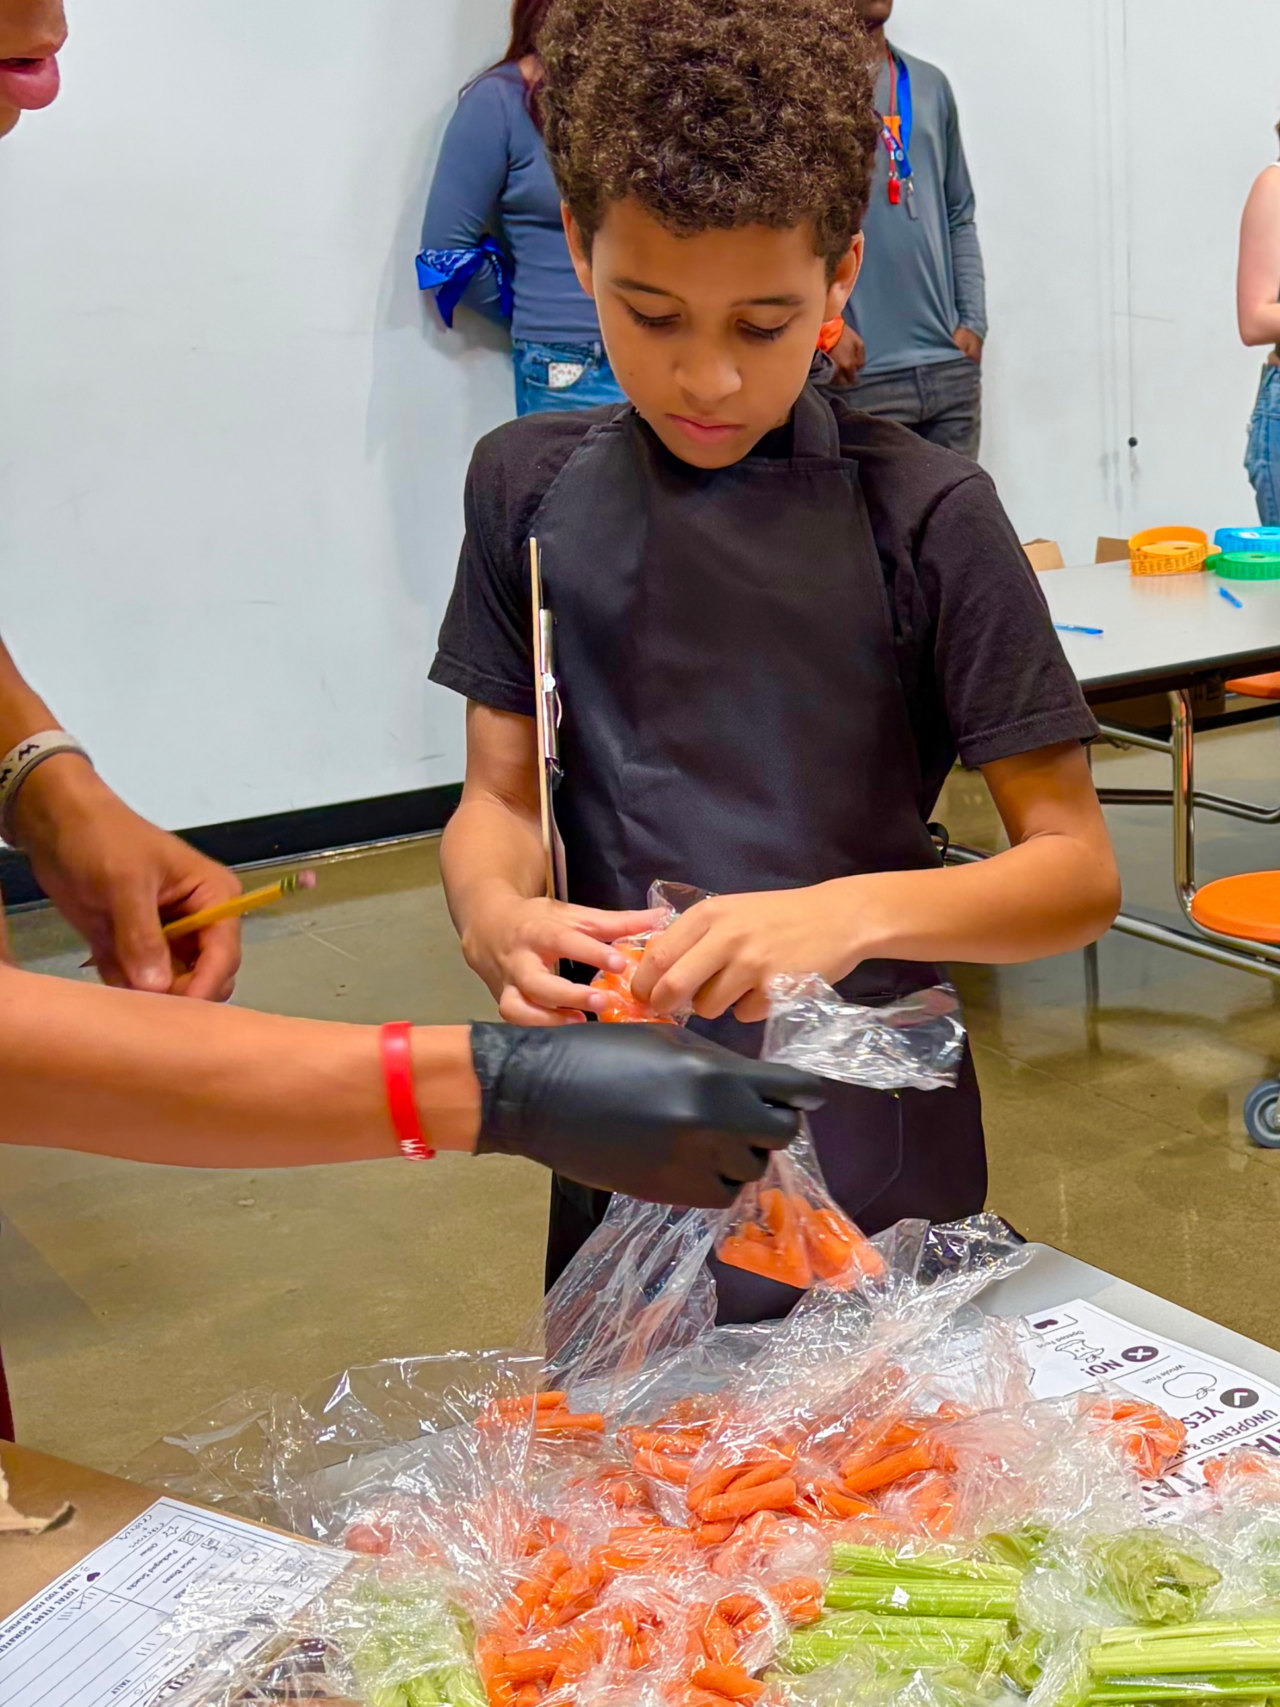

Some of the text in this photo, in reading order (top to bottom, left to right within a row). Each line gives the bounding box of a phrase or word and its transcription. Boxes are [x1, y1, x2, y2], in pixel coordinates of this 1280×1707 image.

[1080, 1359, 1124, 1377] NO!
[1161, 1364, 1186, 1378] Whole
[1200, 1409, 1279, 1445] UNOPENED
[139, 1543, 158, 1556] Other
[126, 1549, 178, 1590] Packaged Snacks
[180, 1556, 198, 1569] Juice
[162, 1569, 182, 1584] Boxes
[4, 1573, 81, 1633] THANK YOU FOR HELPING
[54, 1588, 79, 1605] TOTAL
[30, 1606, 55, 1624] ITEMS
[111, 1679, 131, 1694] TALLY
